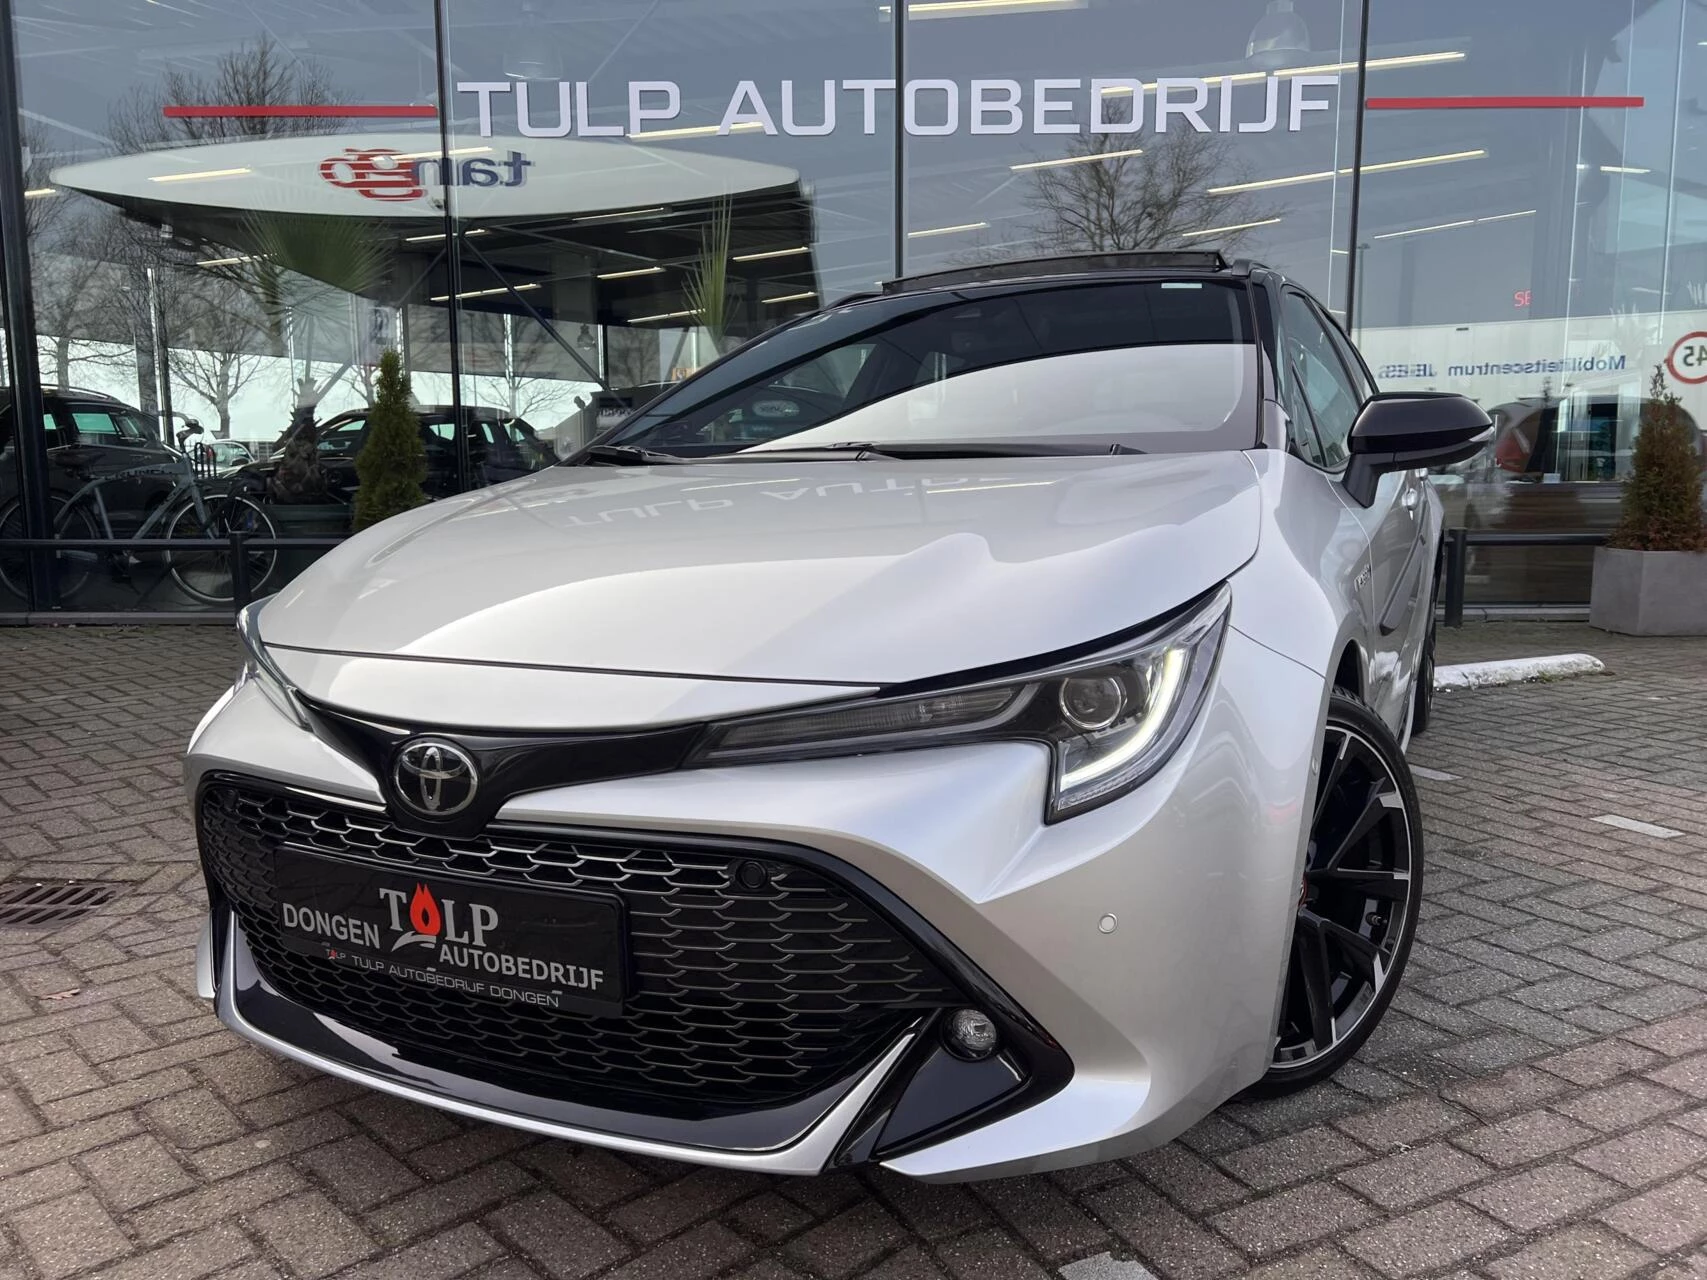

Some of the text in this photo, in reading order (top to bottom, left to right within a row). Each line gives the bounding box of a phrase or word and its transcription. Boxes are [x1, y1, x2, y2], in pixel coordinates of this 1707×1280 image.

[456, 76, 1339, 138] TULP AUTOBEDRIJF
[282, 903, 381, 949] DONGEN
[351, 955, 560, 1008] TULP AUTOBEDRIJF DONGEN
[438, 944, 604, 991] AUTOBEDRIJF
